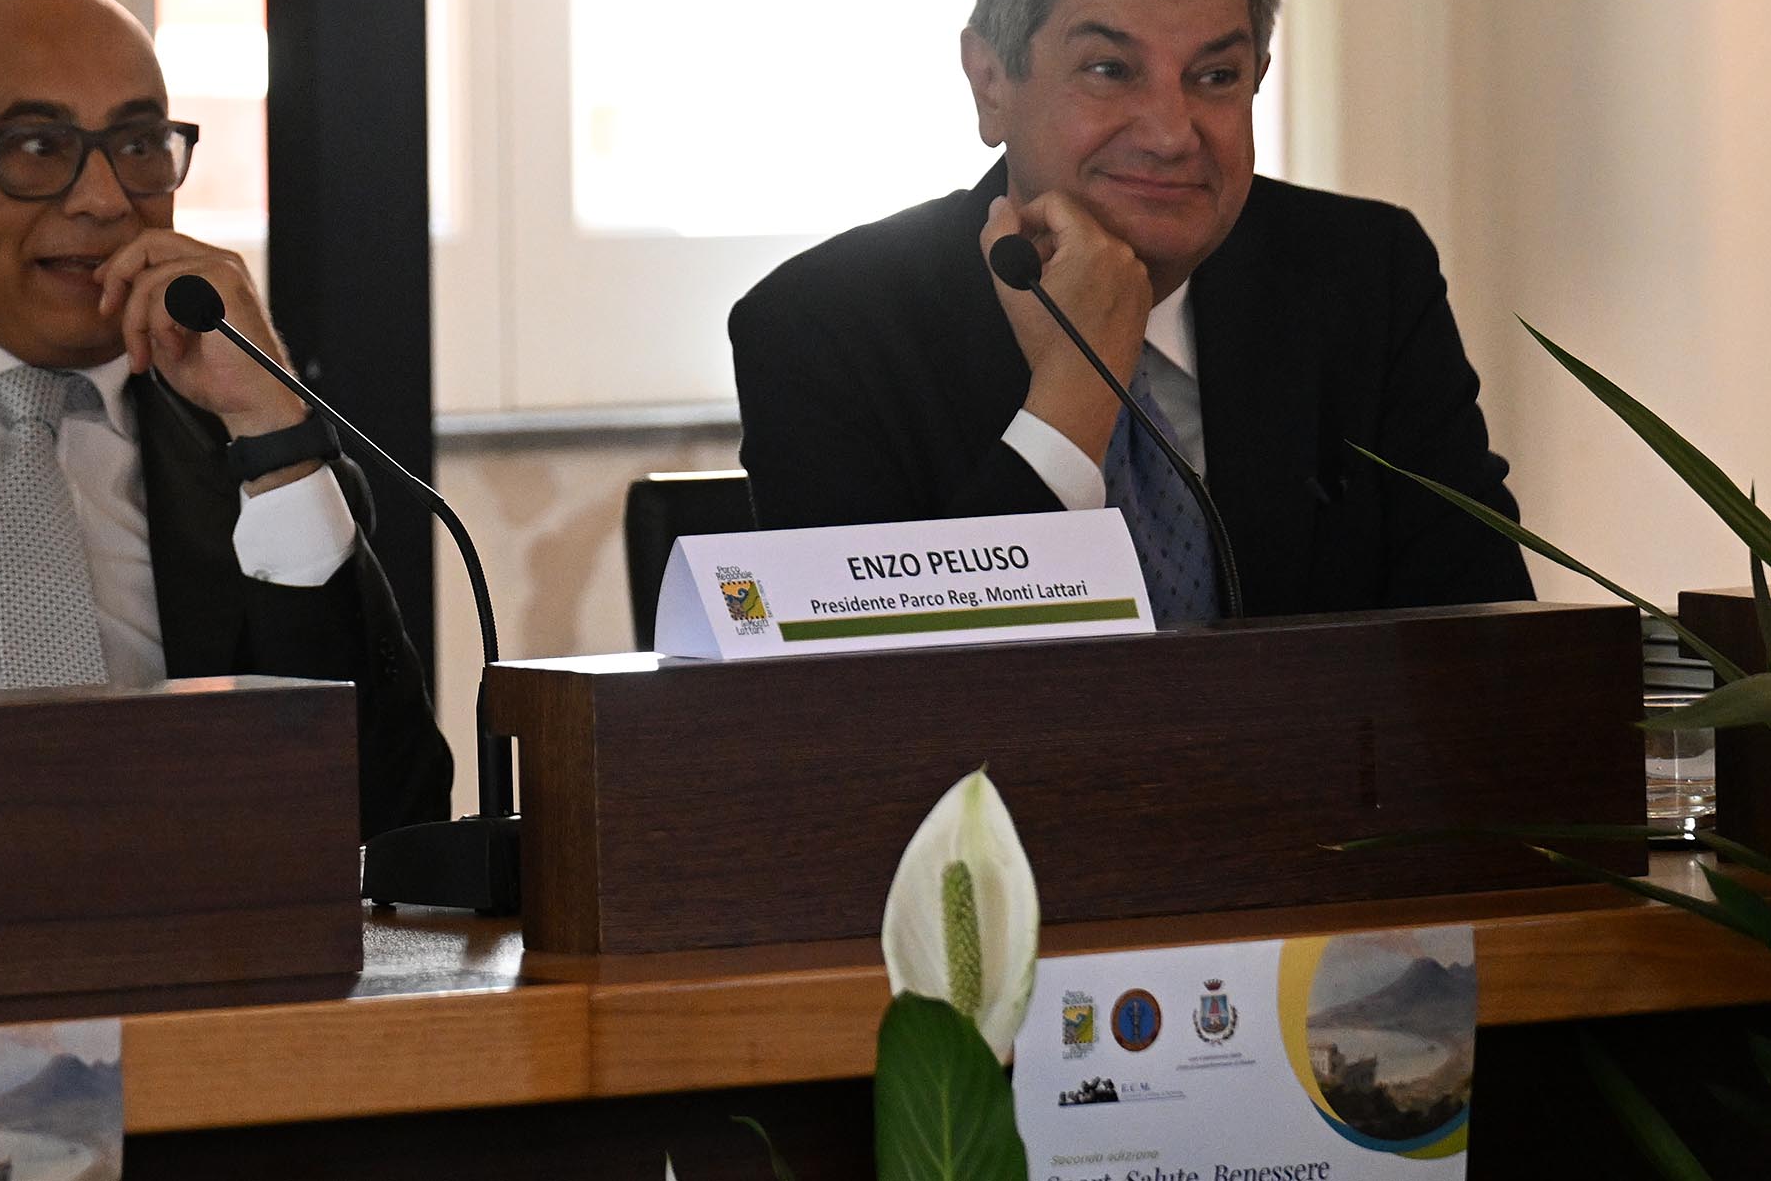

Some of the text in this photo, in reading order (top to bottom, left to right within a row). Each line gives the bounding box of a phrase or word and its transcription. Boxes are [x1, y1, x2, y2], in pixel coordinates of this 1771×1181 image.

[846, 545, 1029, 580] ENZO PELUSO
[810, 580, 1088, 614] Presidente Parco Reg. Monti Lattari
[1213, 1161, 1330, 1181] Benessere
